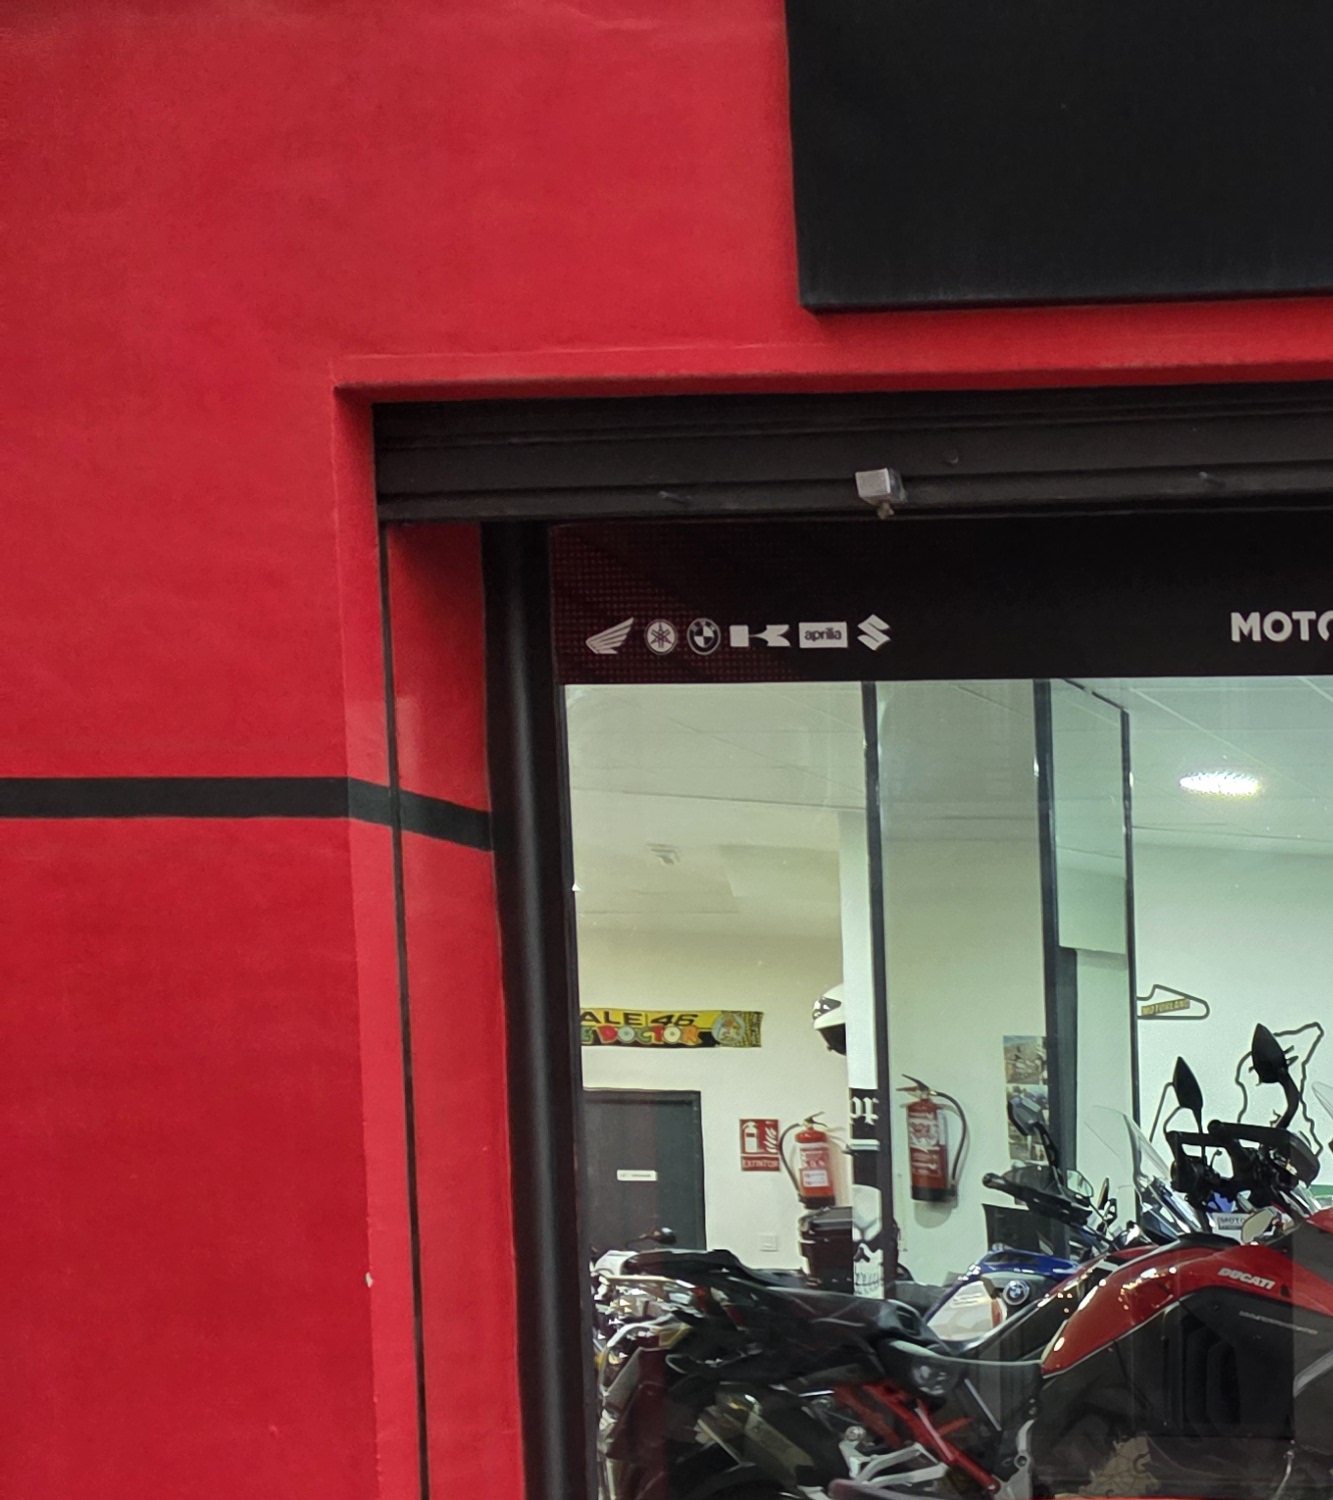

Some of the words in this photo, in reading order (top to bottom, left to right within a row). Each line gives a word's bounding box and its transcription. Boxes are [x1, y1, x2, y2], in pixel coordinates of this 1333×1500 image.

[803, 626, 843, 643] aprilia
[580, 1011, 643, 1026] ALE
[650, 1014, 699, 1026] 46
[597, 1023, 702, 1044] DOCTOR
[1217, 1267, 1277, 1290] DUCATI
